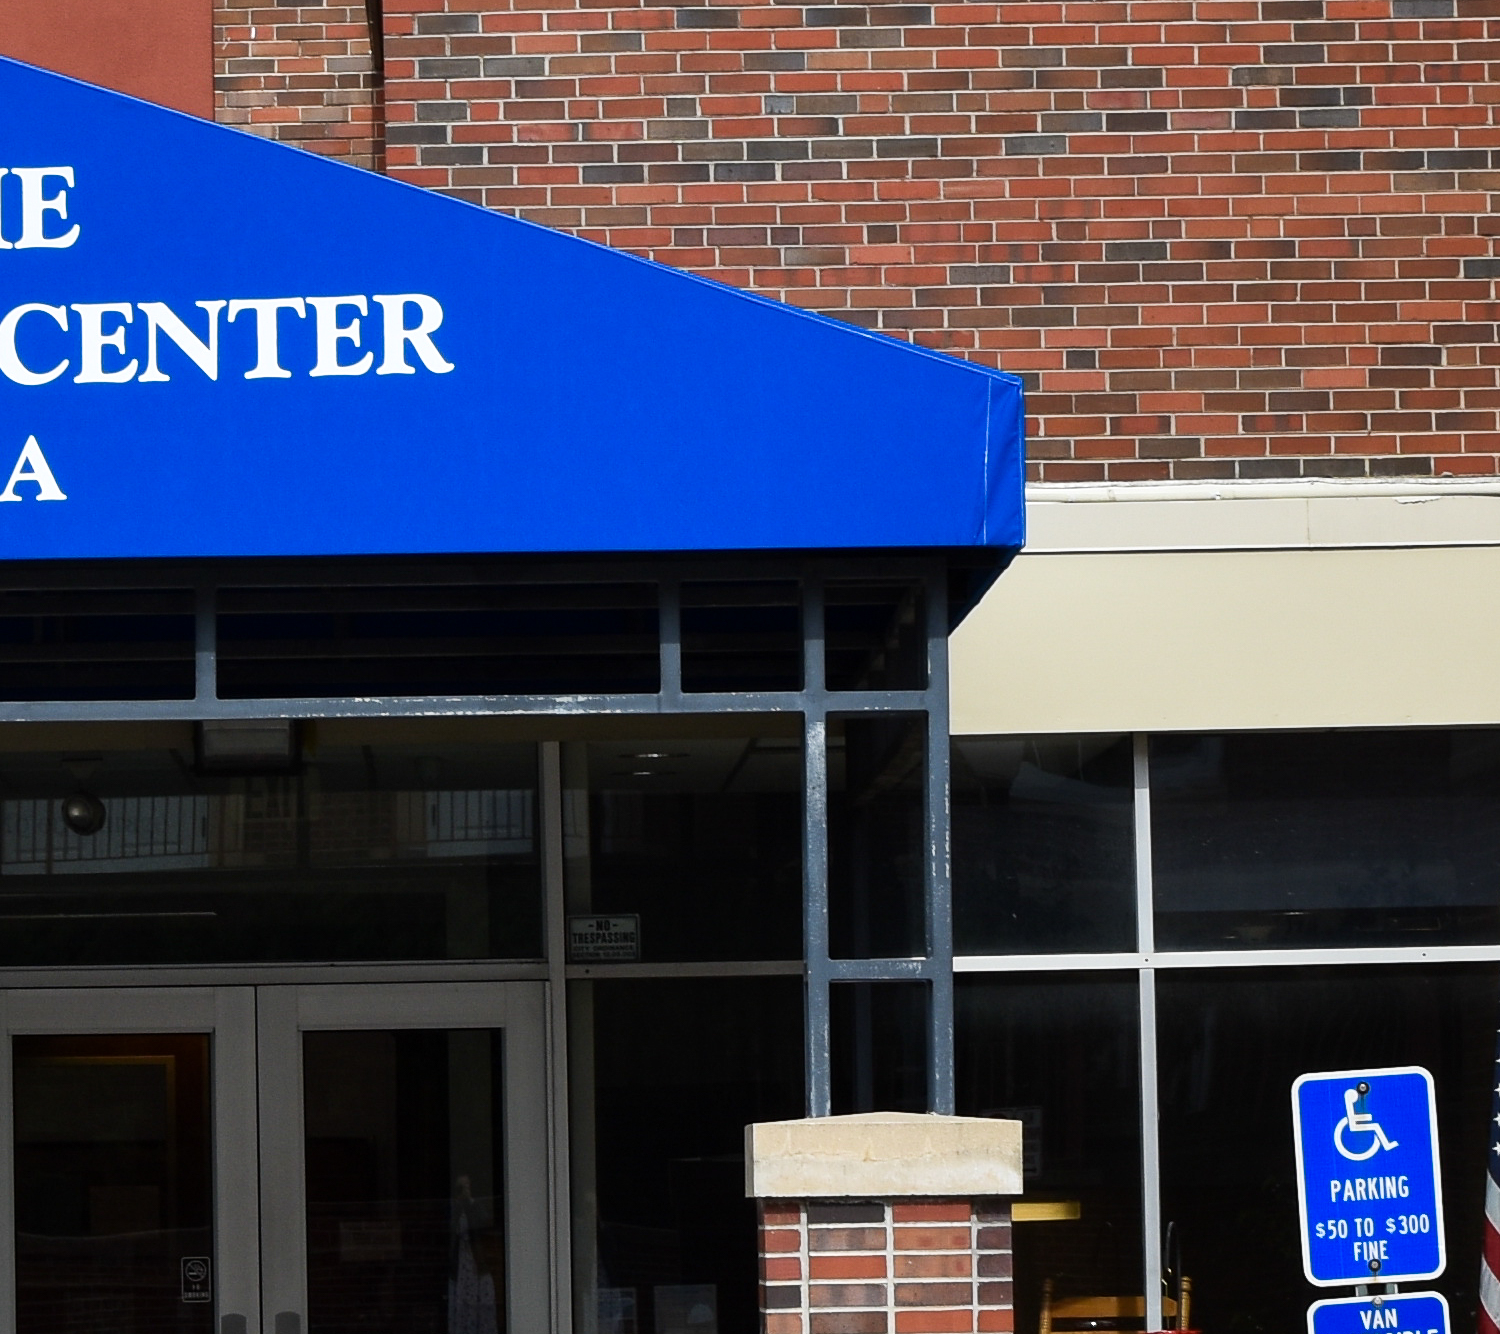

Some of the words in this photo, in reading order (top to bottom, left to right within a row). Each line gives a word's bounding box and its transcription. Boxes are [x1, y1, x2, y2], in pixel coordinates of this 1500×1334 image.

[572, 932, 635, 944] TRESPASSING
[1330, 1175, 1409, 1203] PARKING
[1315, 1219, 1348, 1240] $50
[1354, 1217, 1374, 1238] TO
[1385, 1213, 1430, 1235] $300
[1353, 1239, 1389, 1262] FINE
[1359, 1308, 1398, 1330] VAN
